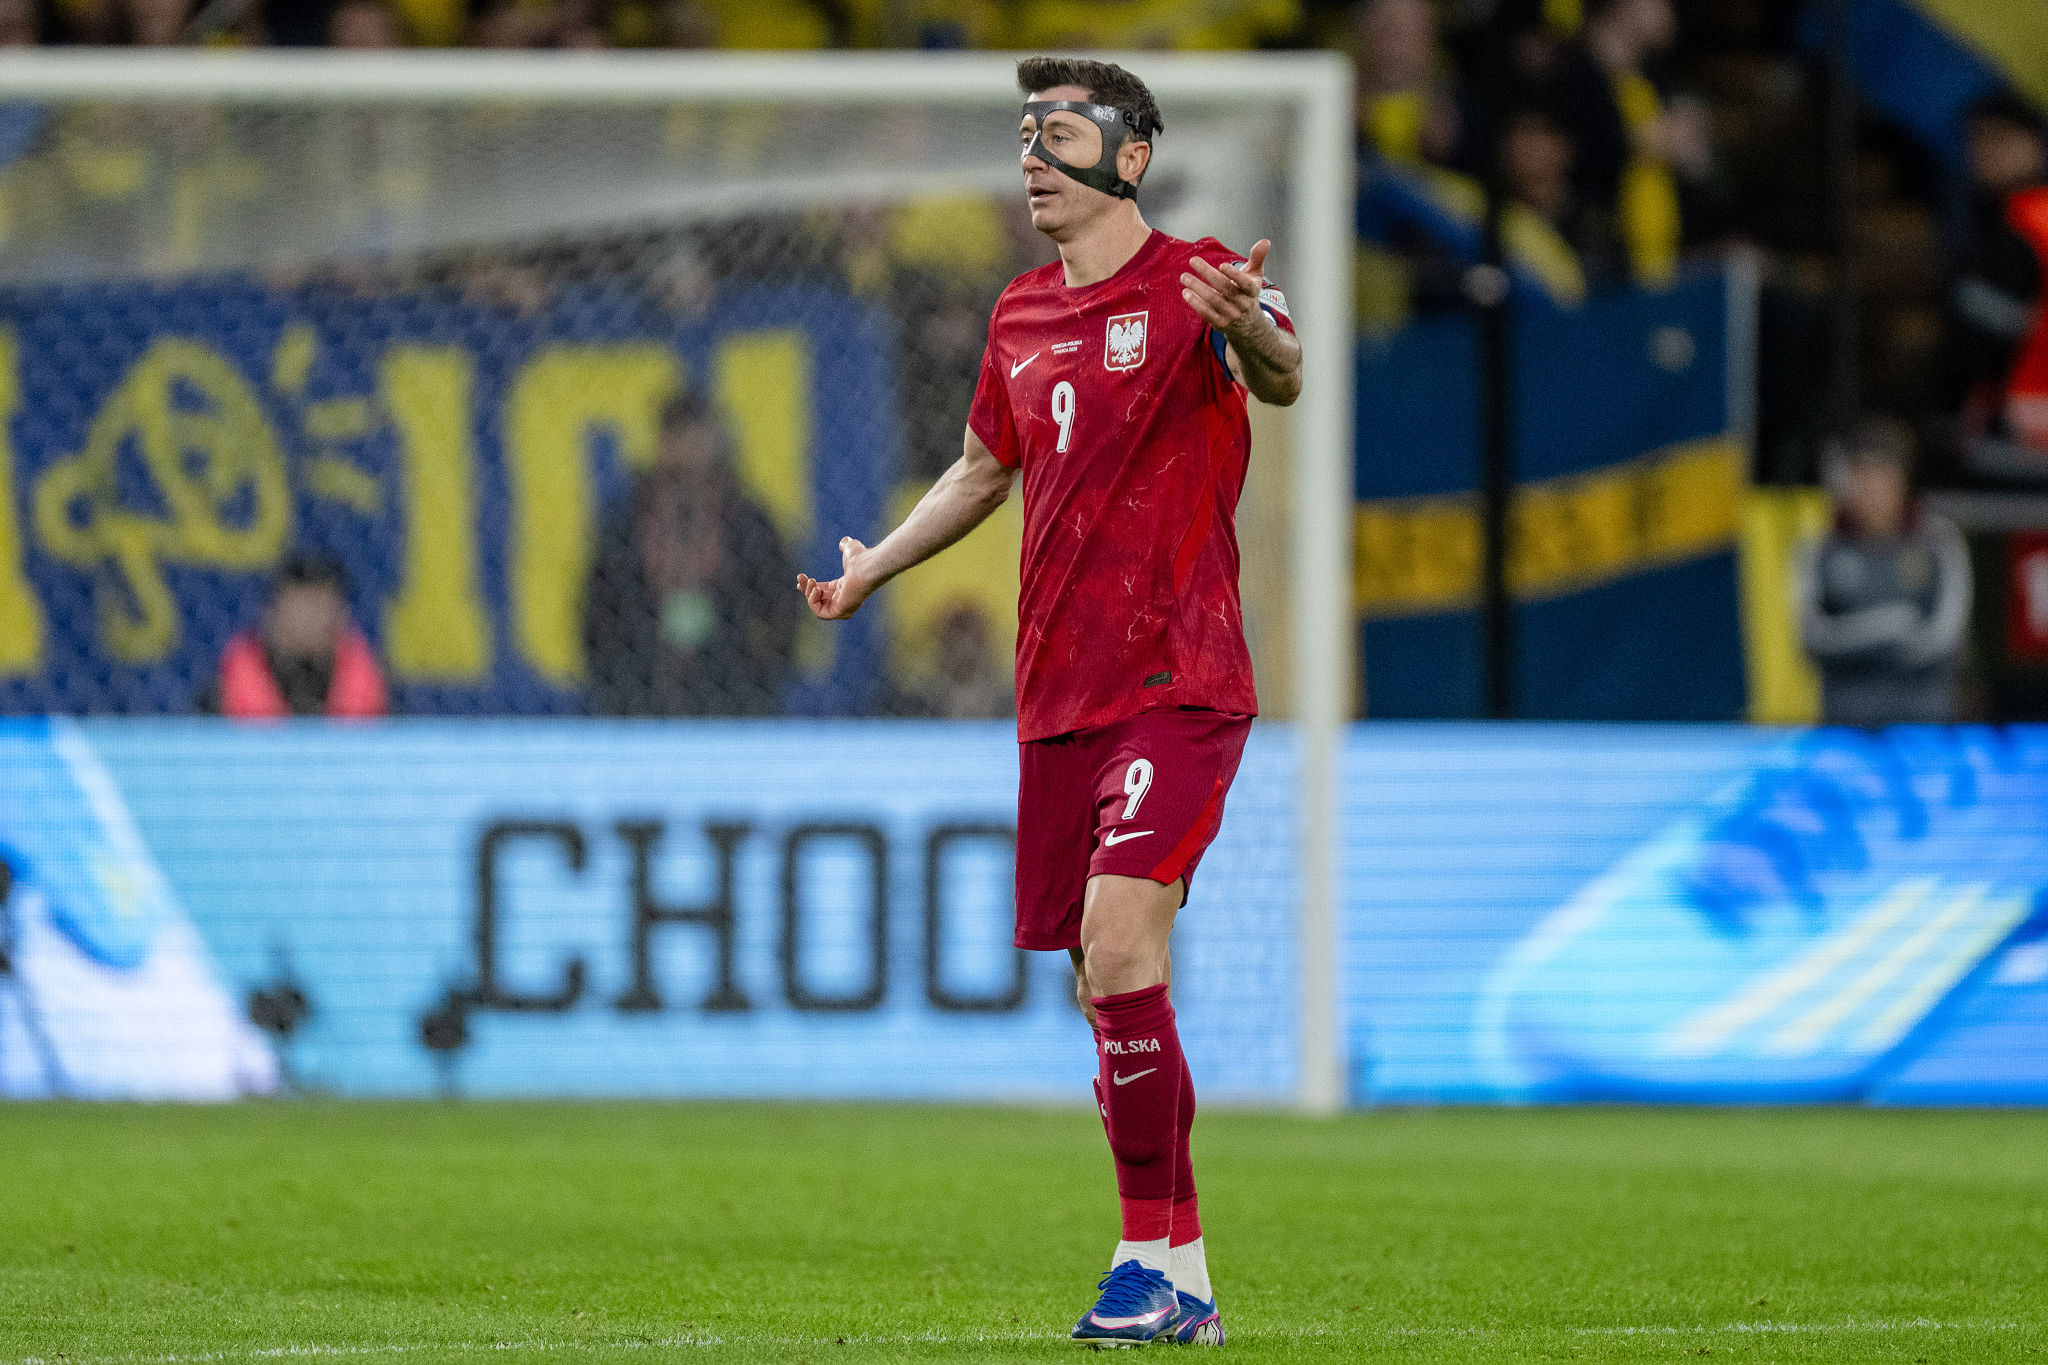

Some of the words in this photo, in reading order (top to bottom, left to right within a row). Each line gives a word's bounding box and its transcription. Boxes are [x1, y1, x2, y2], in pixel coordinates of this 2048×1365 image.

[1052, 381, 1076, 453] 9
[1121, 758, 1154, 820] 9
[478, 815, 1082, 1012] CHOO
[1104, 1038, 1161, 1055] POLSKA
